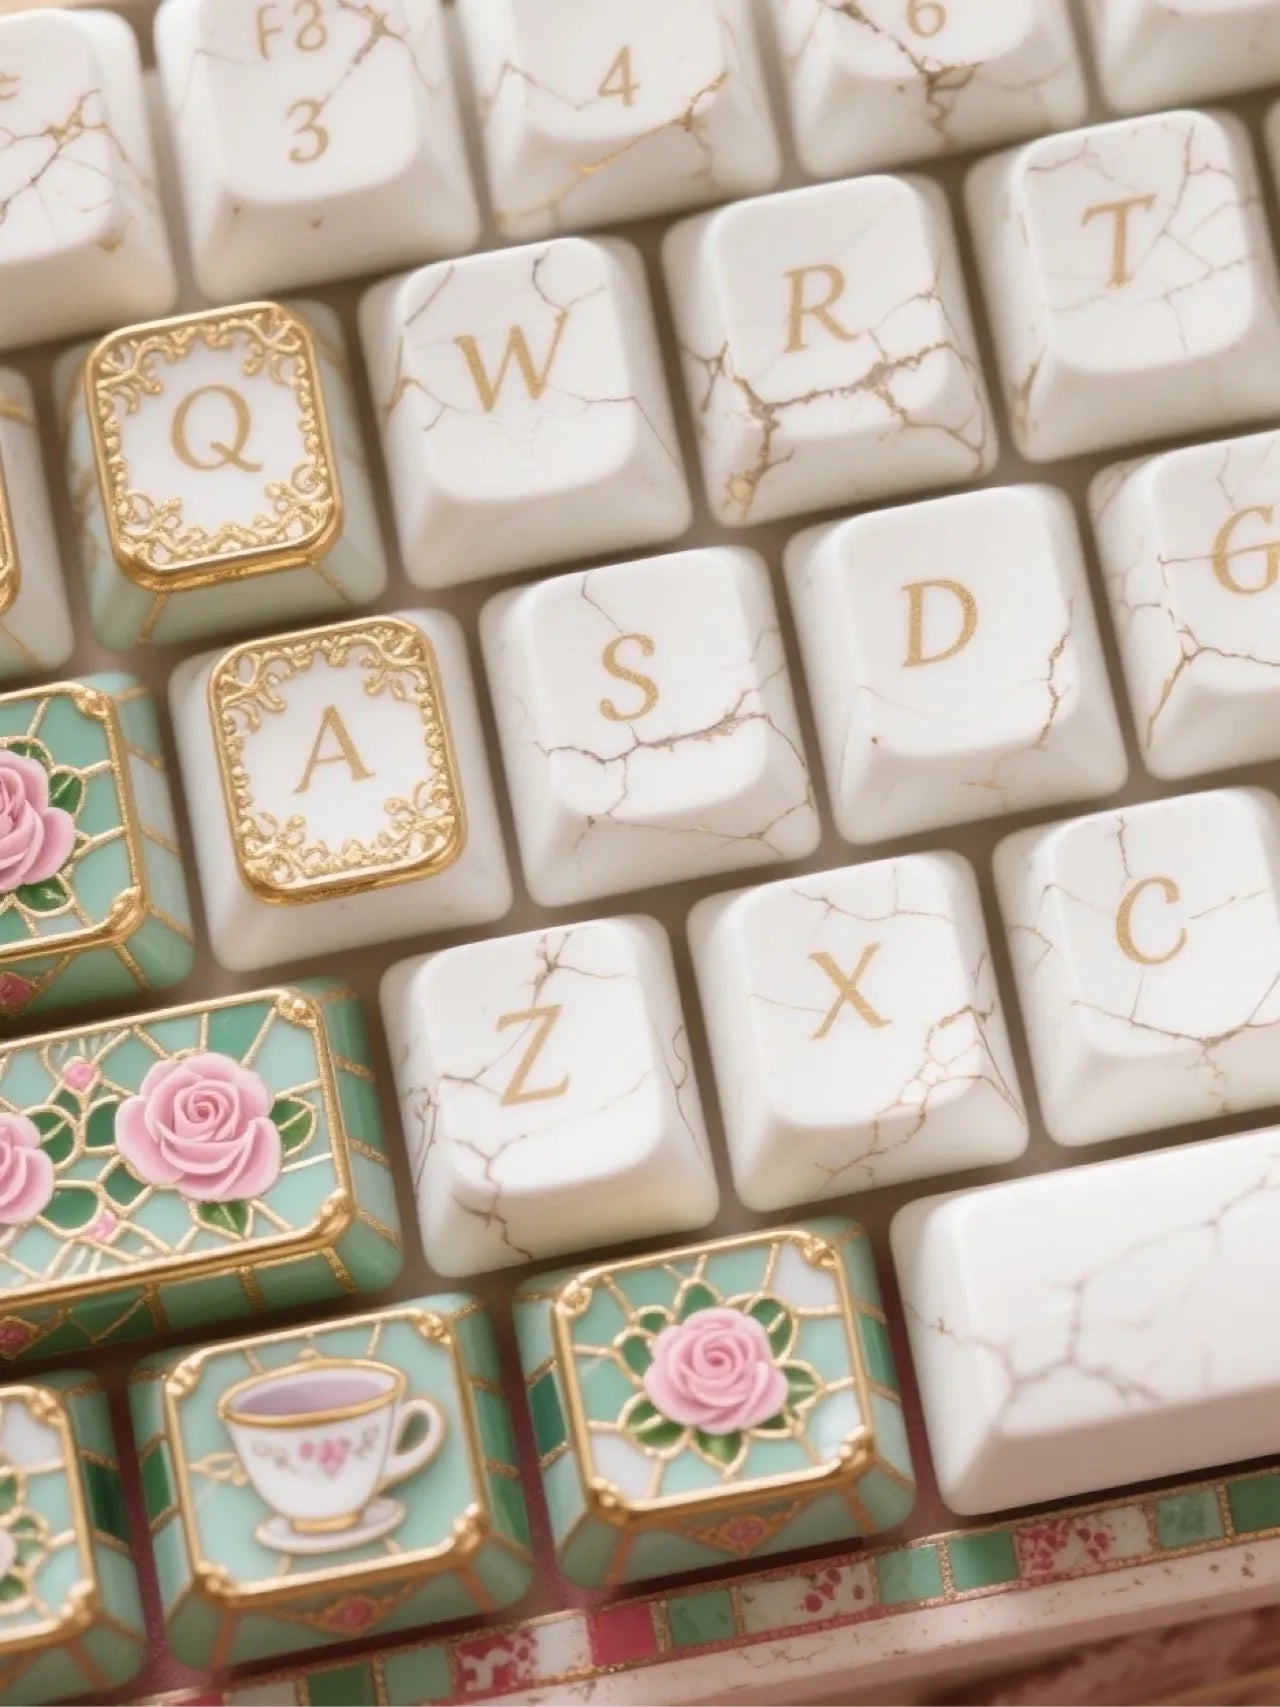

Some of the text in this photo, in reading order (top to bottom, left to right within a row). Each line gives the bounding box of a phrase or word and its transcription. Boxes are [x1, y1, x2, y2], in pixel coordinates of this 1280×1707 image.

[907, 0, 947, 38] 6
[598, 45, 640, 107] 4
[286, 100, 329, 164] 3
[1081, 194, 1157, 289] T
[782, 263, 859, 354] R
[453, 311, 569, 413] W
[170, 385, 262, 472] Q
[1212, 504, 1280, 595] G
[901, 579, 979, 669] D
[599, 633, 659, 722] S
[293, 704, 376, 794] A
[1114, 876, 1188, 966] C
[808, 942, 893, 1041] X
[495, 1004, 570, 1107] Z
